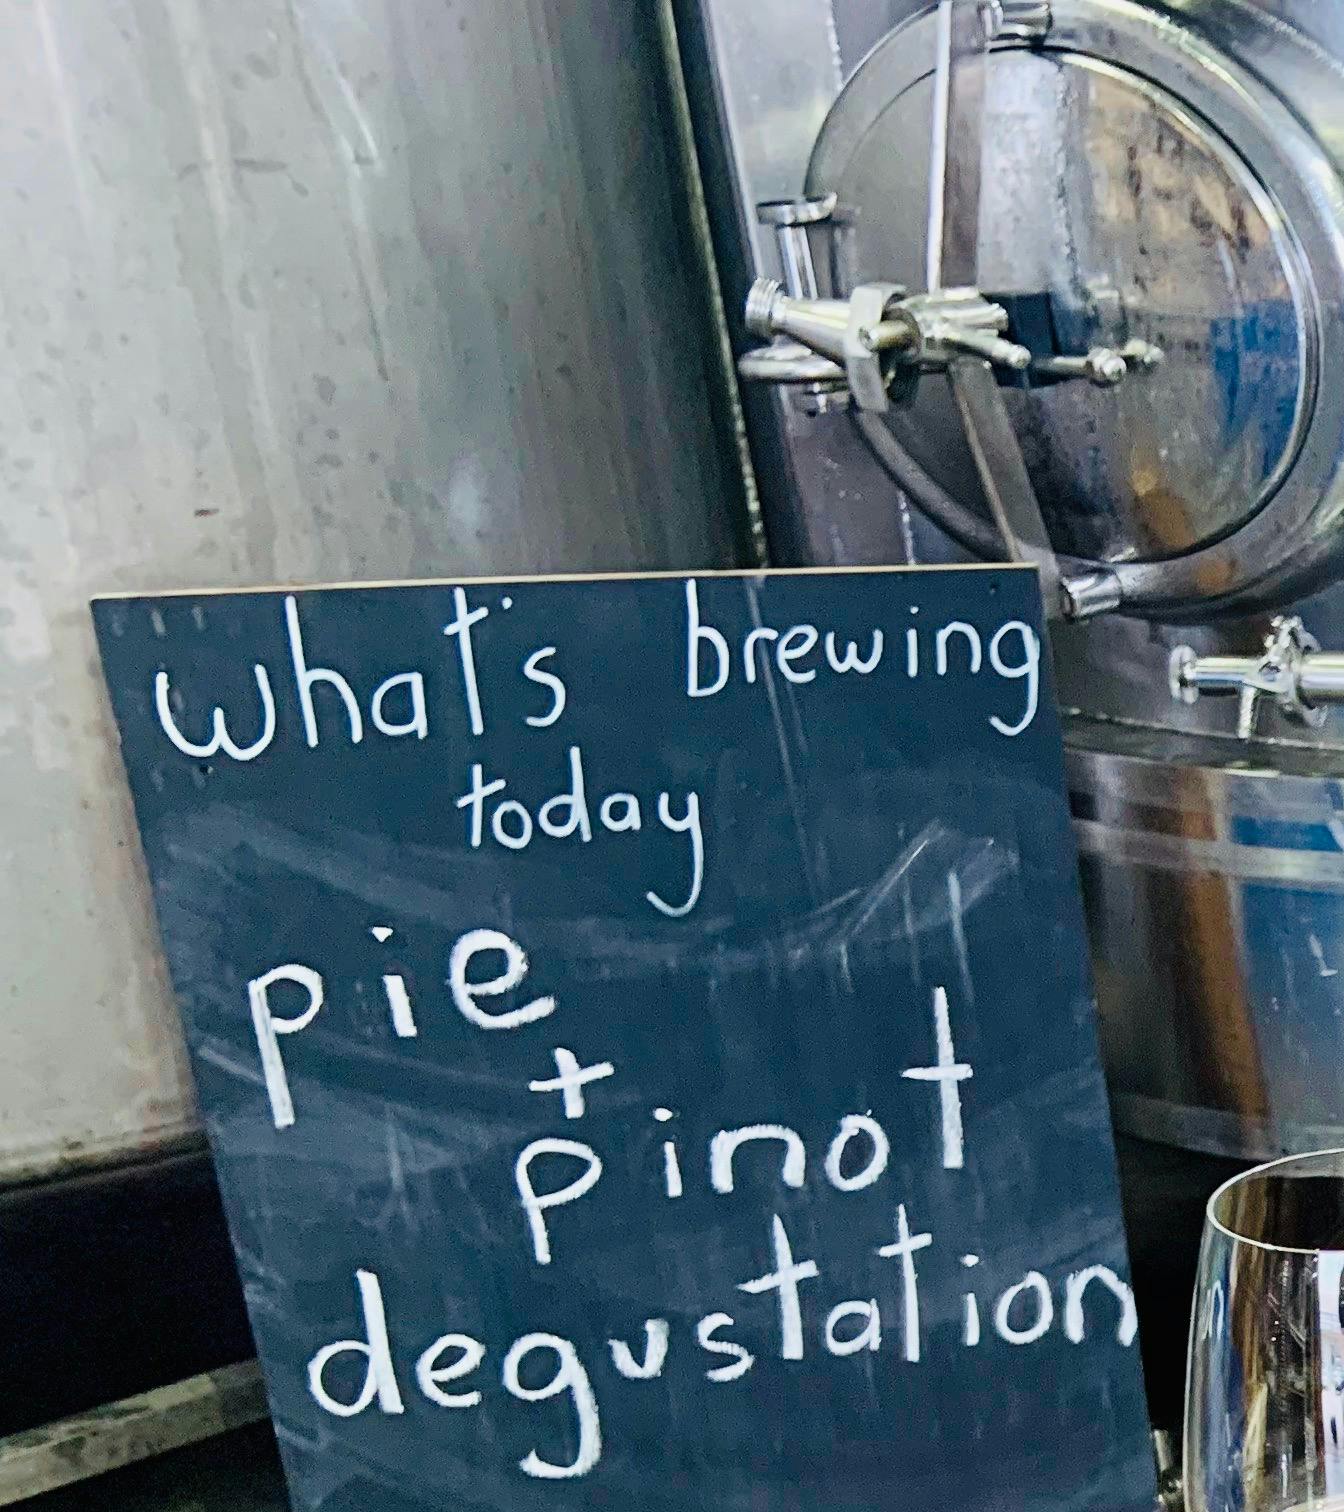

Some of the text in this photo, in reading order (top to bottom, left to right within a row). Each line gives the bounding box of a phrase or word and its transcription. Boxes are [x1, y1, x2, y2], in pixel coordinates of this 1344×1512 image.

[155, 578, 1042, 762] what's brewing
[456, 747, 703, 916] today
[247, 926, 556, 1130] pie
[513, 986, 975, 1267] pinot
[306, 1203, 1140, 1480] degustation
